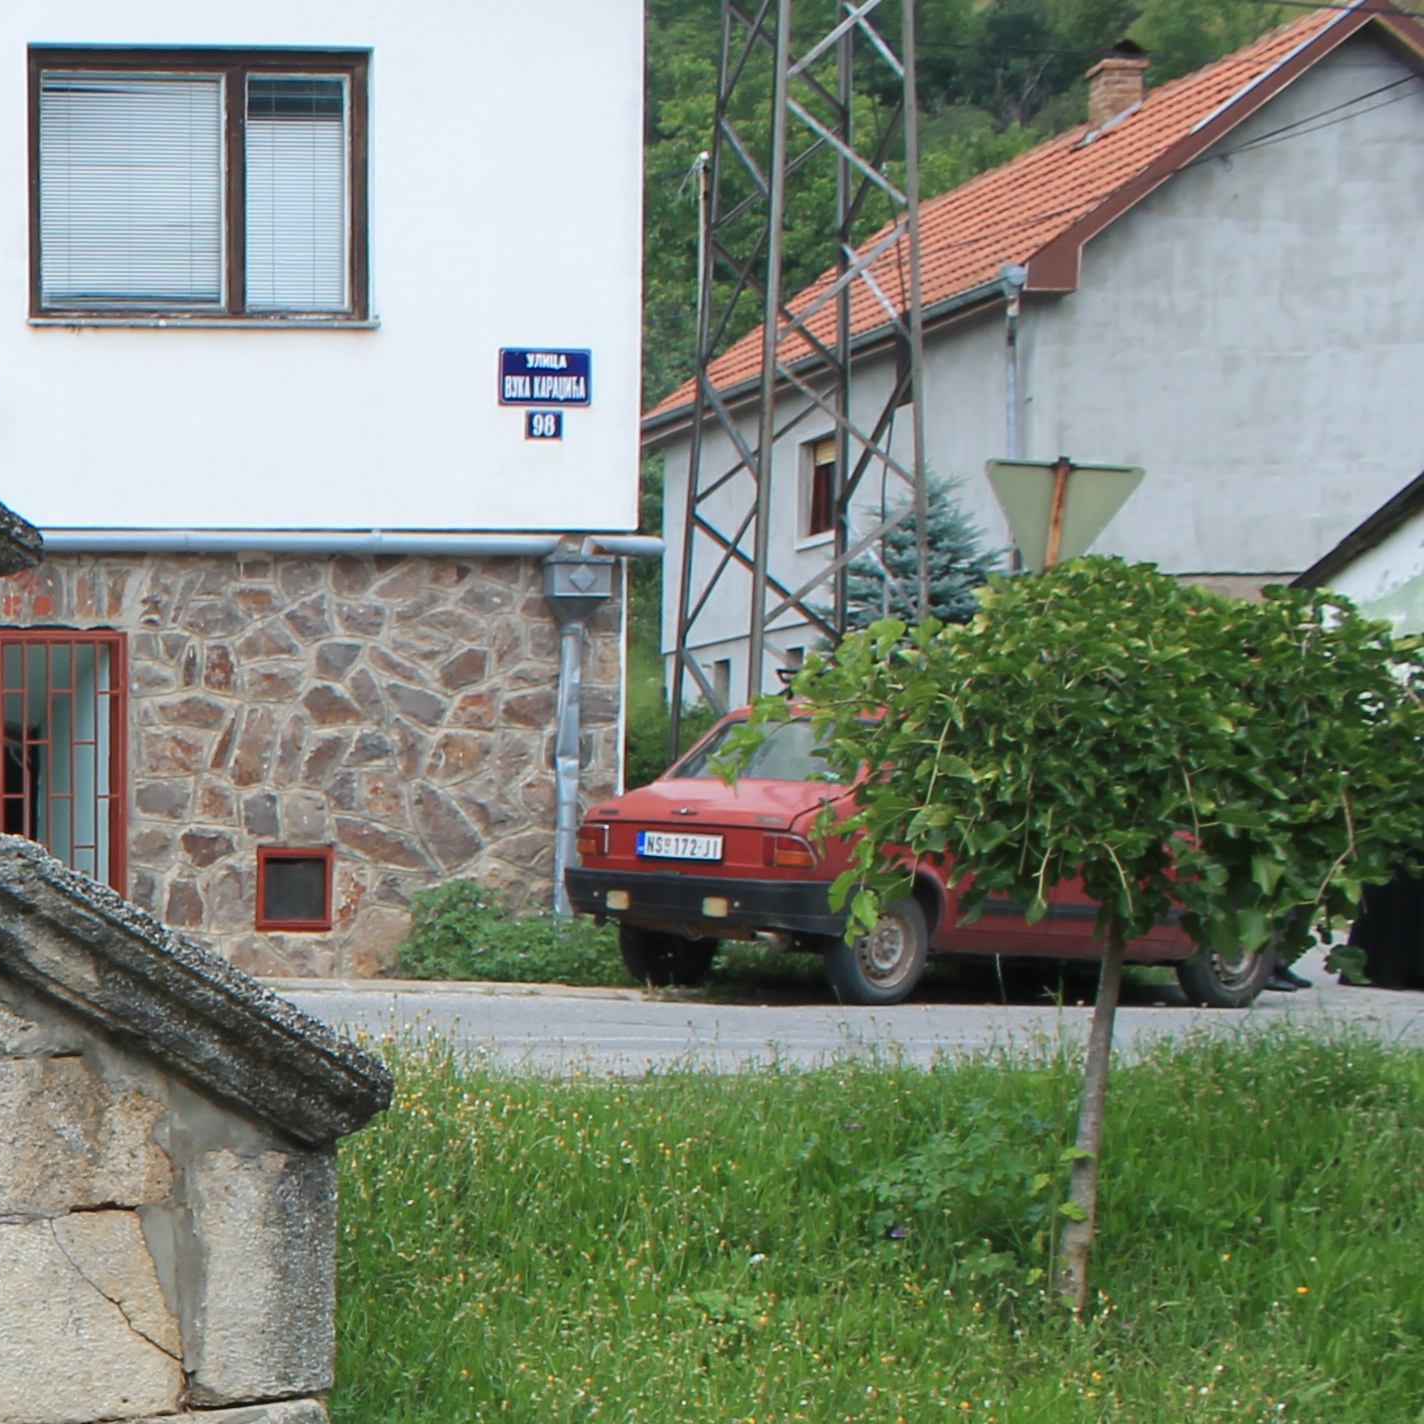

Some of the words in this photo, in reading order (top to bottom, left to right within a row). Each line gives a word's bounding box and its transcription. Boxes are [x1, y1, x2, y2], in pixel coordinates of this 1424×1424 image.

[526, 353, 568, 371] УЛИЦА
[504, 375, 531, 399] ВУКА
[533, 376, 586, 401] КАРАЏИЋА
[532, 413, 556, 437] 98
[647, 836, 663, 854] NS
